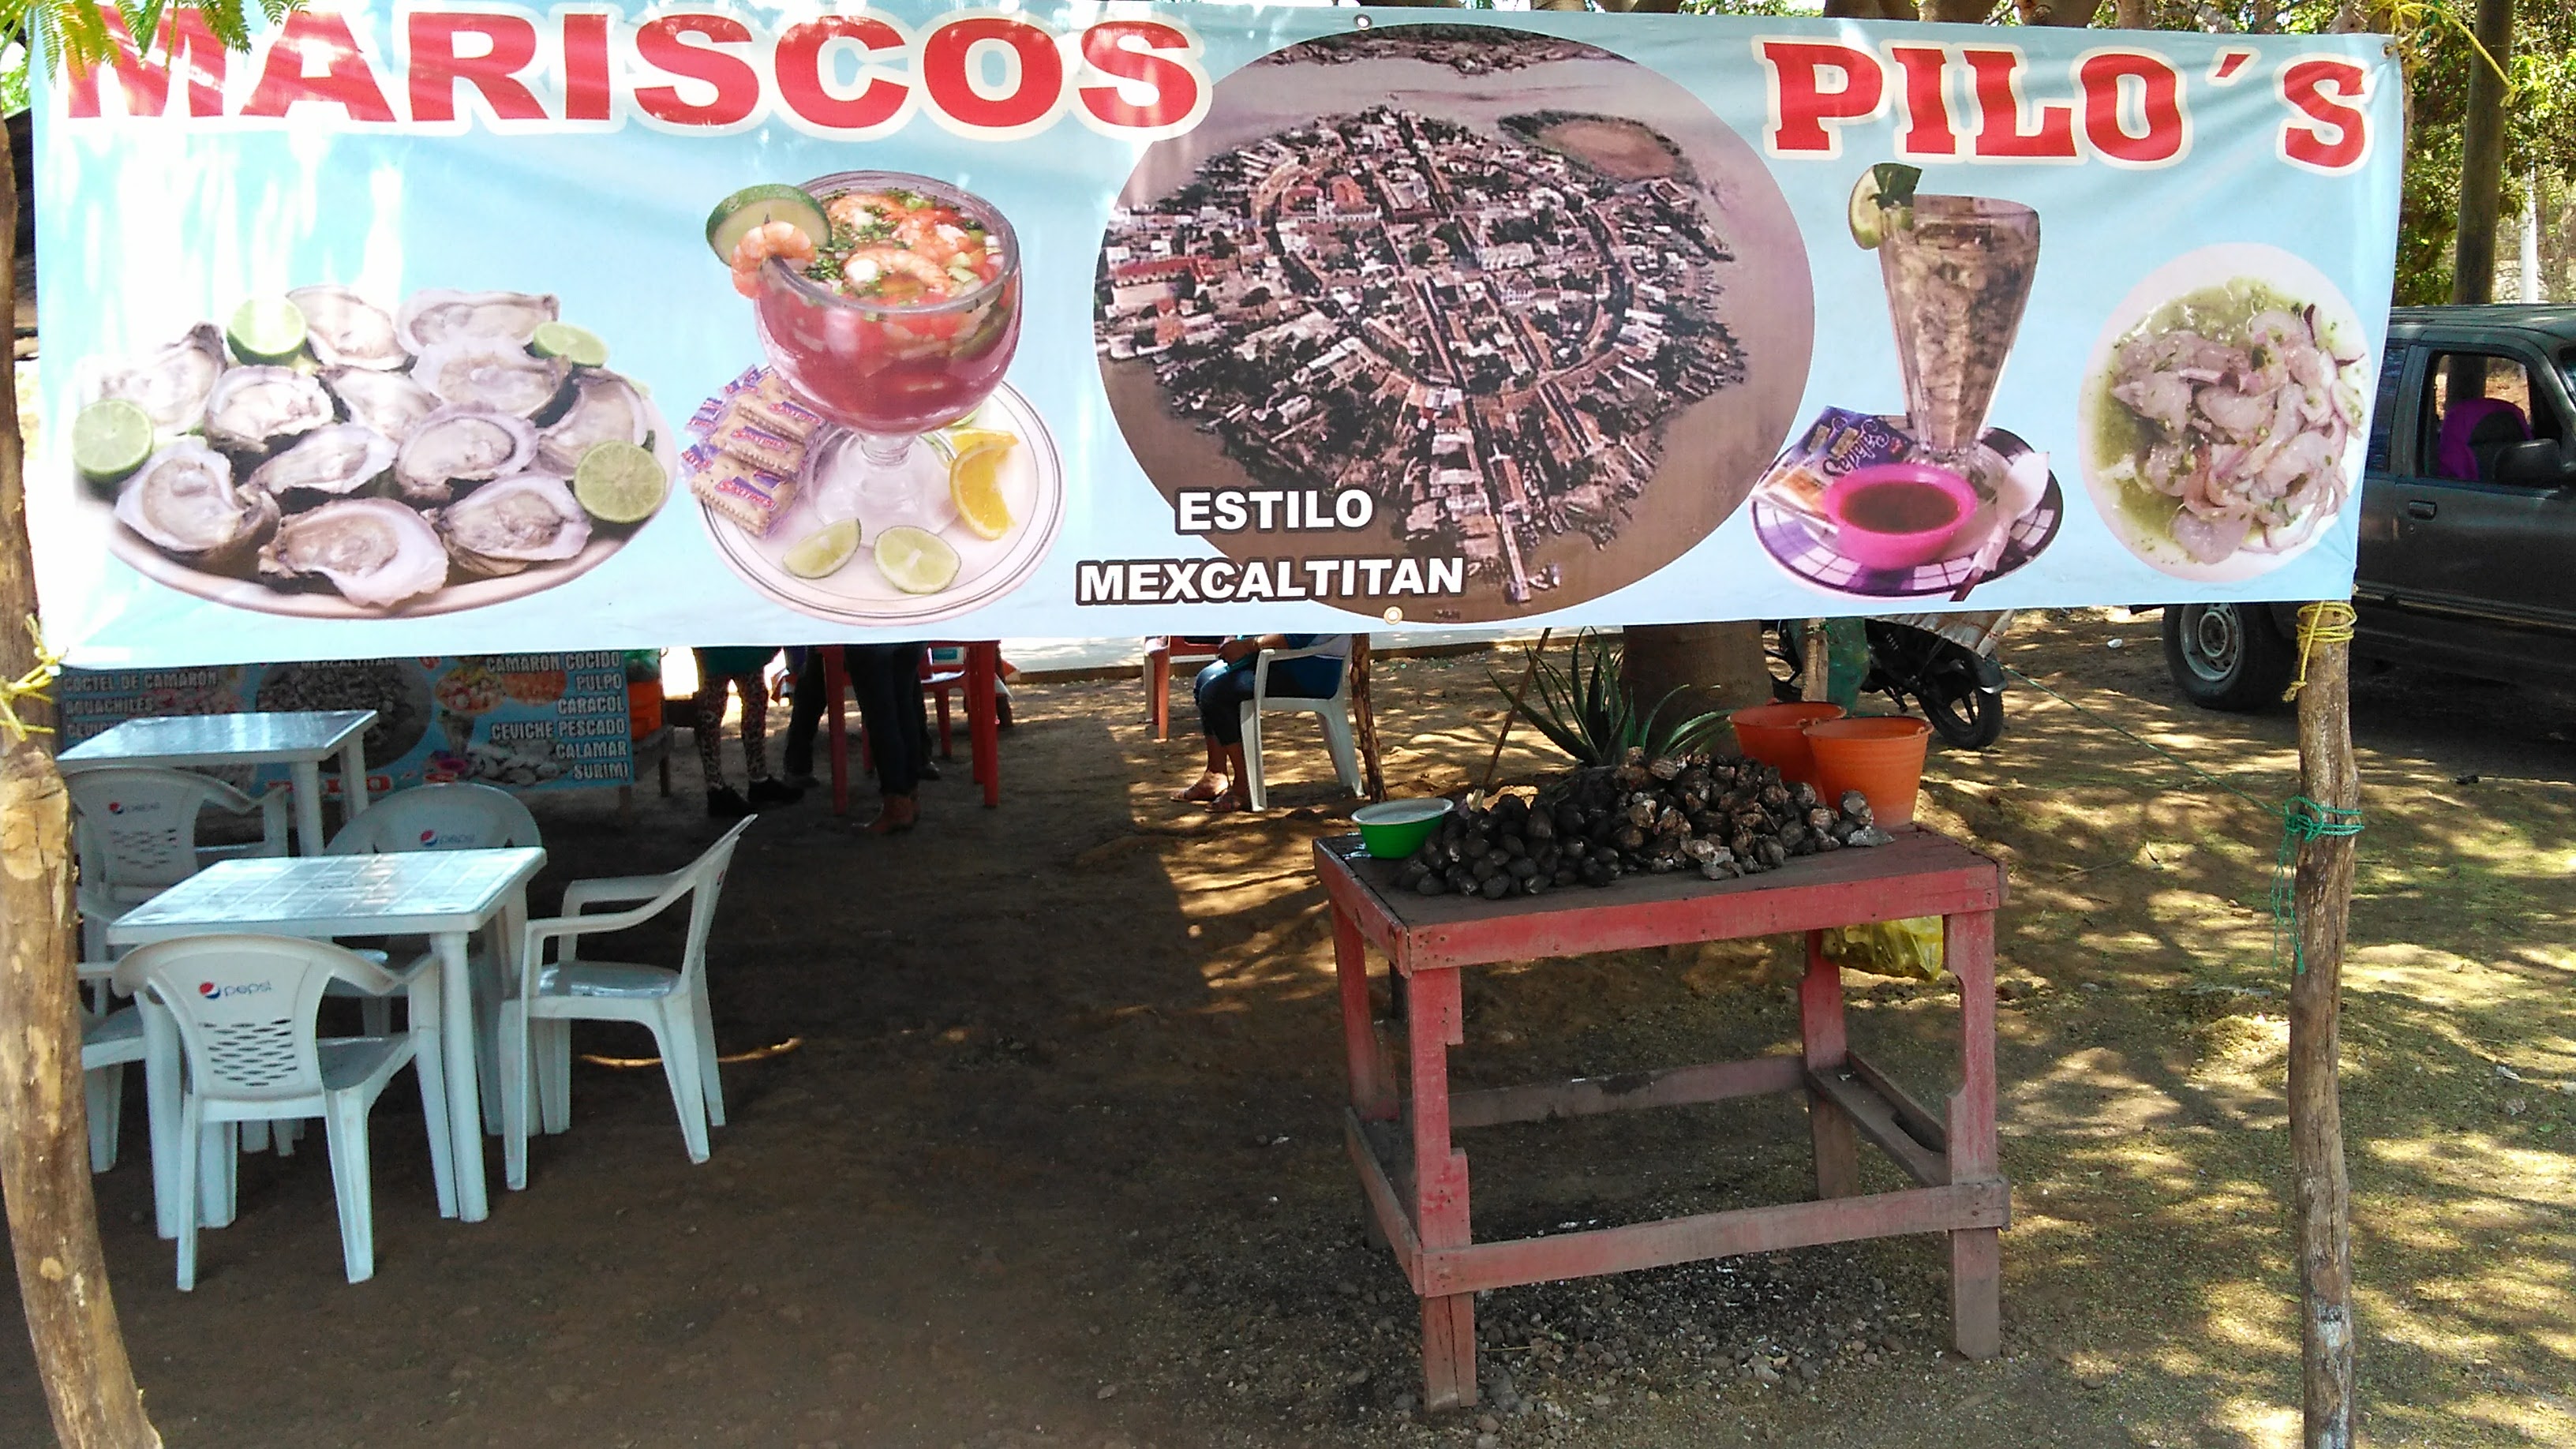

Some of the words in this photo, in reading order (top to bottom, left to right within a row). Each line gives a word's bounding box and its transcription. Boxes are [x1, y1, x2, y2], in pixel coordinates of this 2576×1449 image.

[62, 4, 1197, 128] MARISCOS
[1178, 489, 1374, 531] ESTILO
[1080, 556, 1464, 601] MEXCALTITAN
[486, 654, 560, 672] CAMARON
[565, 652, 620, 669] COCIDO
[63, 674, 114, 692] COCTEL
[120, 673, 139, 690] DE
[144, 671, 218, 689] CAMARON
[576, 673, 623, 691] PULPO
[557, 696, 625, 714] CARACOL
[491, 721, 553, 739] CEVICHE
[558, 718, 625, 736] PESCADO
[556, 741, 627, 758] CALAMAR
[573, 762, 629, 779] SURIMI
[224, 981, 271, 996] pepsi
